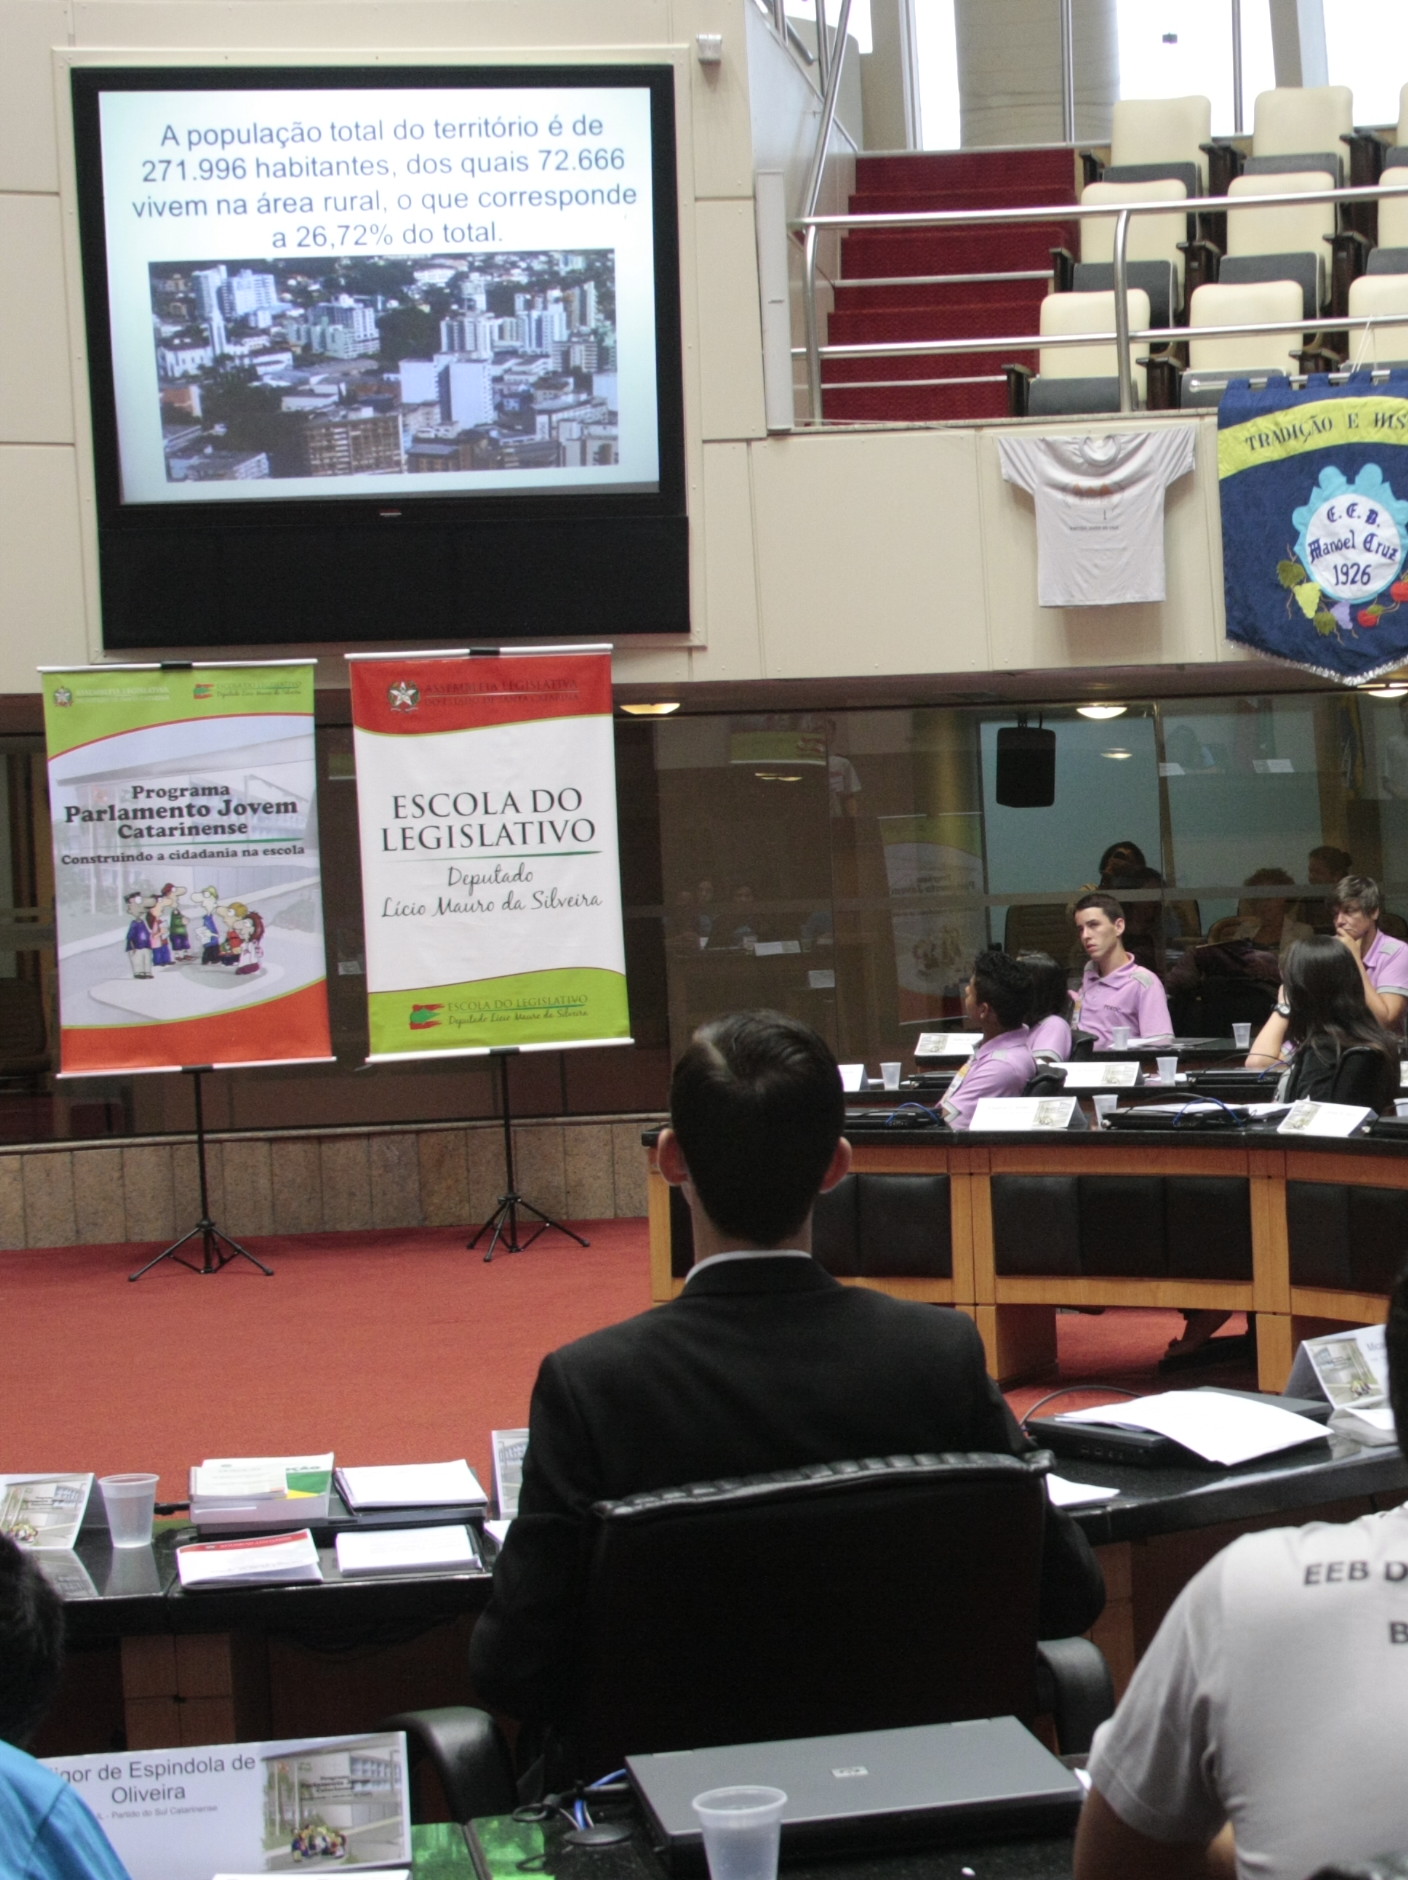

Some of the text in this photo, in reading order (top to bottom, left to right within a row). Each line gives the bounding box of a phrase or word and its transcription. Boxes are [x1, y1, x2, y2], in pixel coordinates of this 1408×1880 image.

[161, 114, 603, 151] A população total do território é de
[142, 148, 625, 182] 271.996 habitantes, dos quais 72.666
[132, 183, 637, 218] vivem na área rural, o que corresponde
[272, 221, 503, 249] a 26,72% do total.
[1245, 414, 1333, 451] TRADIÇÃO
[1347, 412, 1359, 430] E
[1308, 529, 1399, 564] Manoel Cruz
[1333, 562, 1372, 586] 1926
[131, 785, 230, 802] Programa
[392, 787, 583, 820] ESCOLA DO
[64, 799, 298, 823] Parlamento Jovem
[117, 822, 248, 840] Catarinense
[381, 818, 596, 852] LEGISLATIVO
[61, 845, 305, 865] Construindo a cidadania na escola
[448, 862, 534, 896] Deputado
[381, 887, 603, 918] Lício Mauro da Silveira
[447, 994, 589, 1012] ESCOLA DO LEGISLATIVO
[1304, 1561, 1369, 1586] EEB
[98, 1764, 122, 1781] de
[129, 1756, 225, 1780] Espindola
[232, 1754, 256, 1771] de
[111, 1784, 186, 1804] Oliveira
